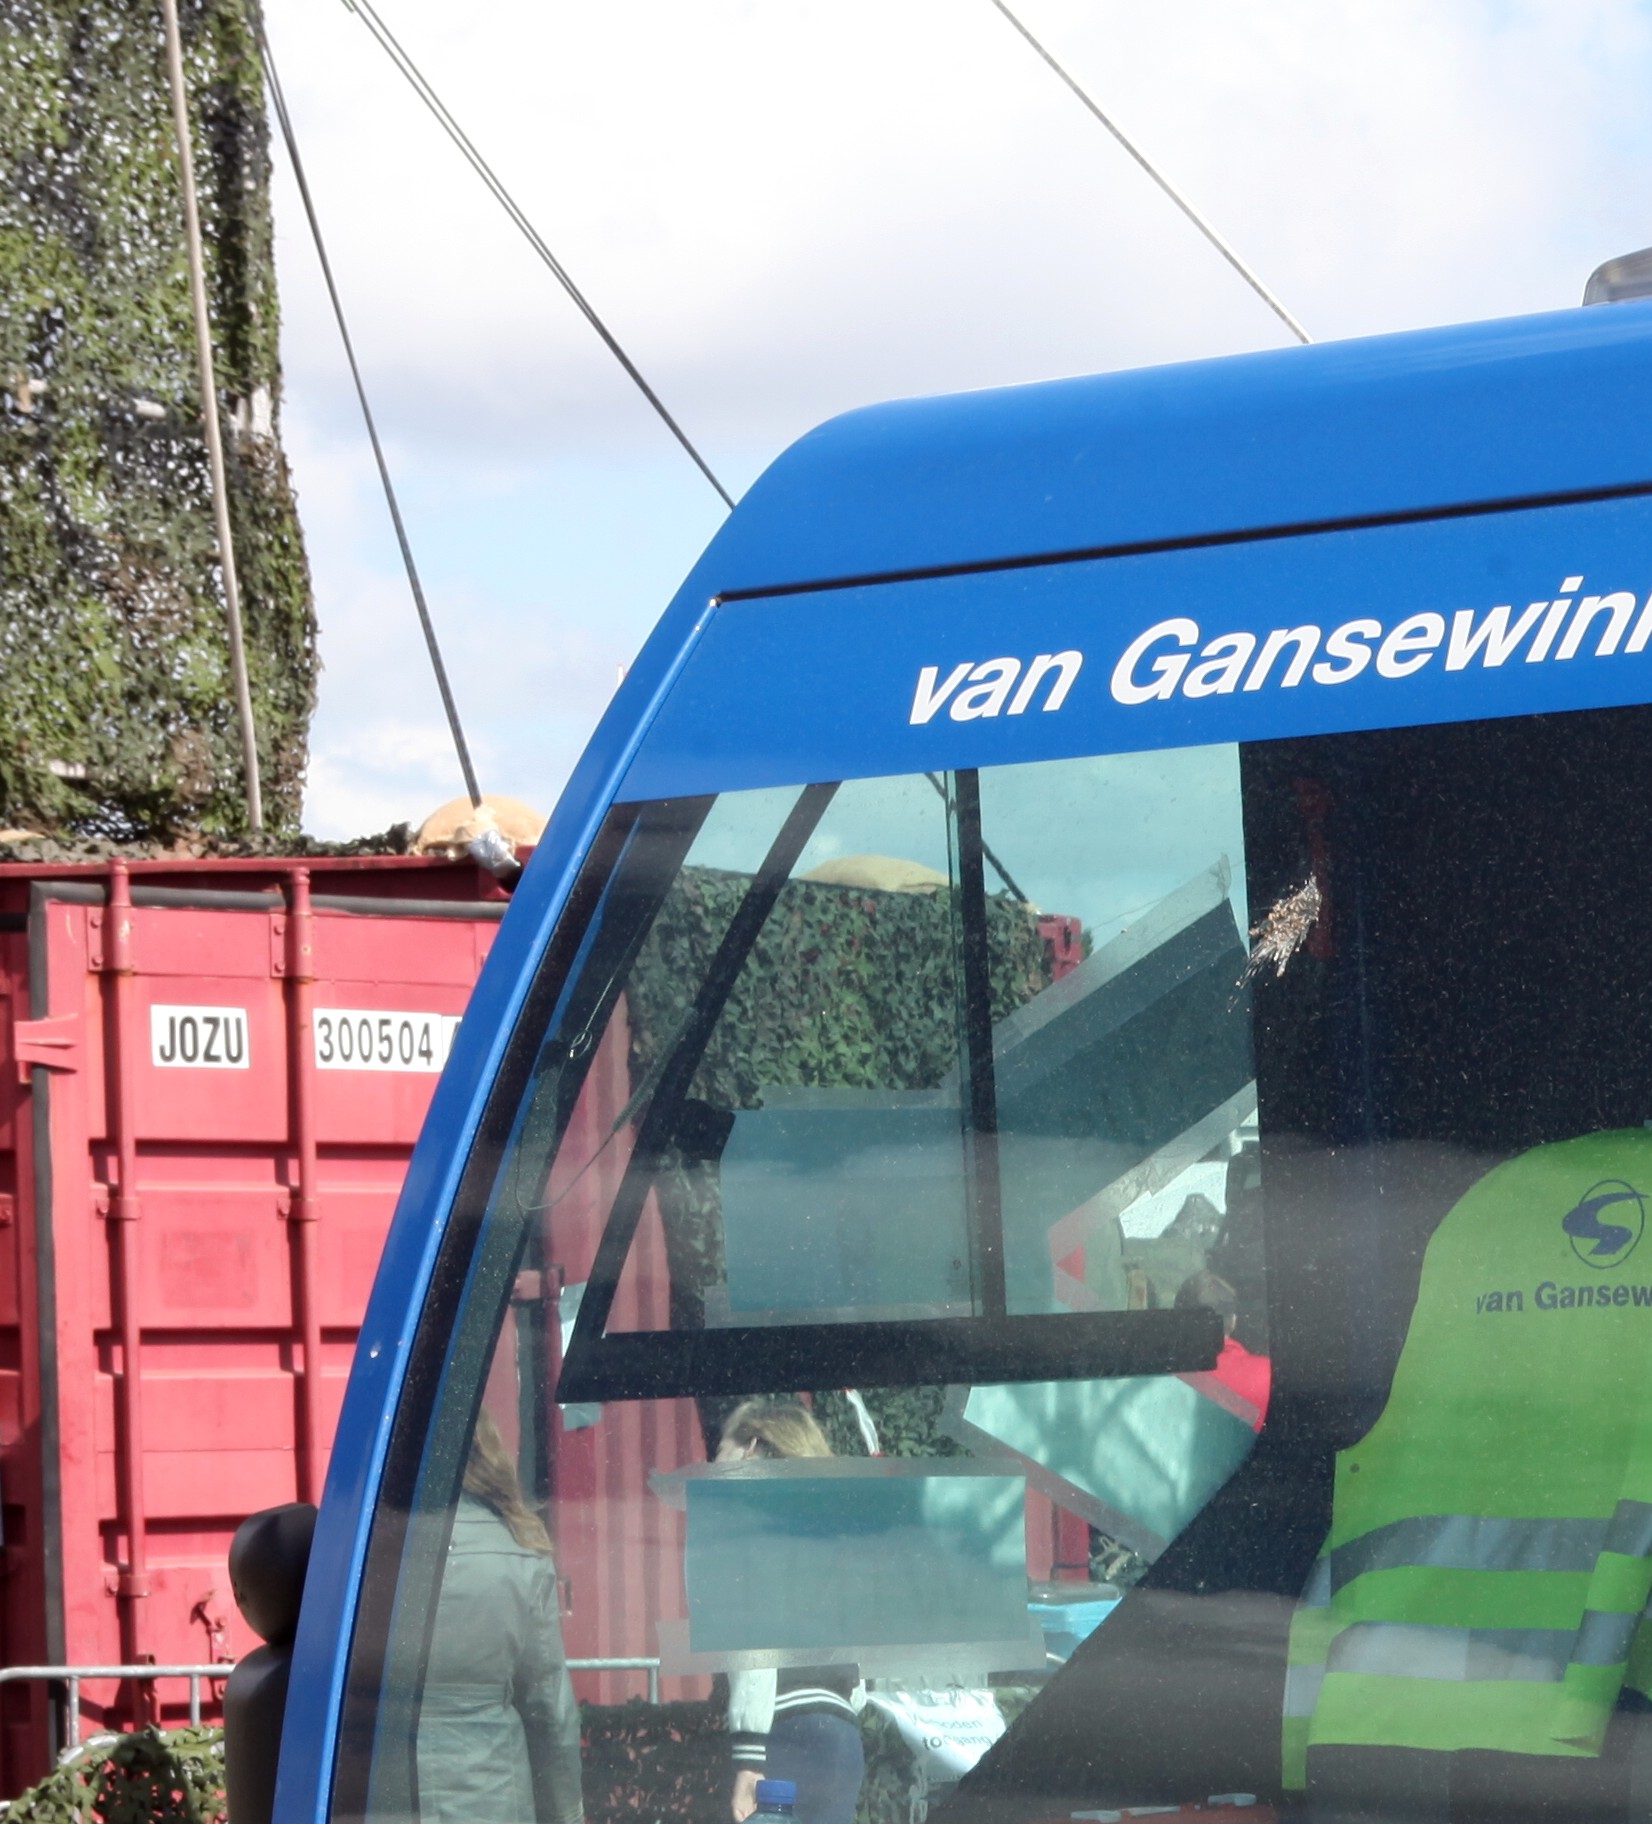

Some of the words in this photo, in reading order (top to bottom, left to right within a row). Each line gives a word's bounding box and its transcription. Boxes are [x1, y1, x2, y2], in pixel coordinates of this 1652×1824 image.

[909, 651, 1081, 727] van
[159, 1015, 243, 1064] JOZU
[318, 1016, 433, 1067] 300504
[1476, 1289, 1523, 1315] van
